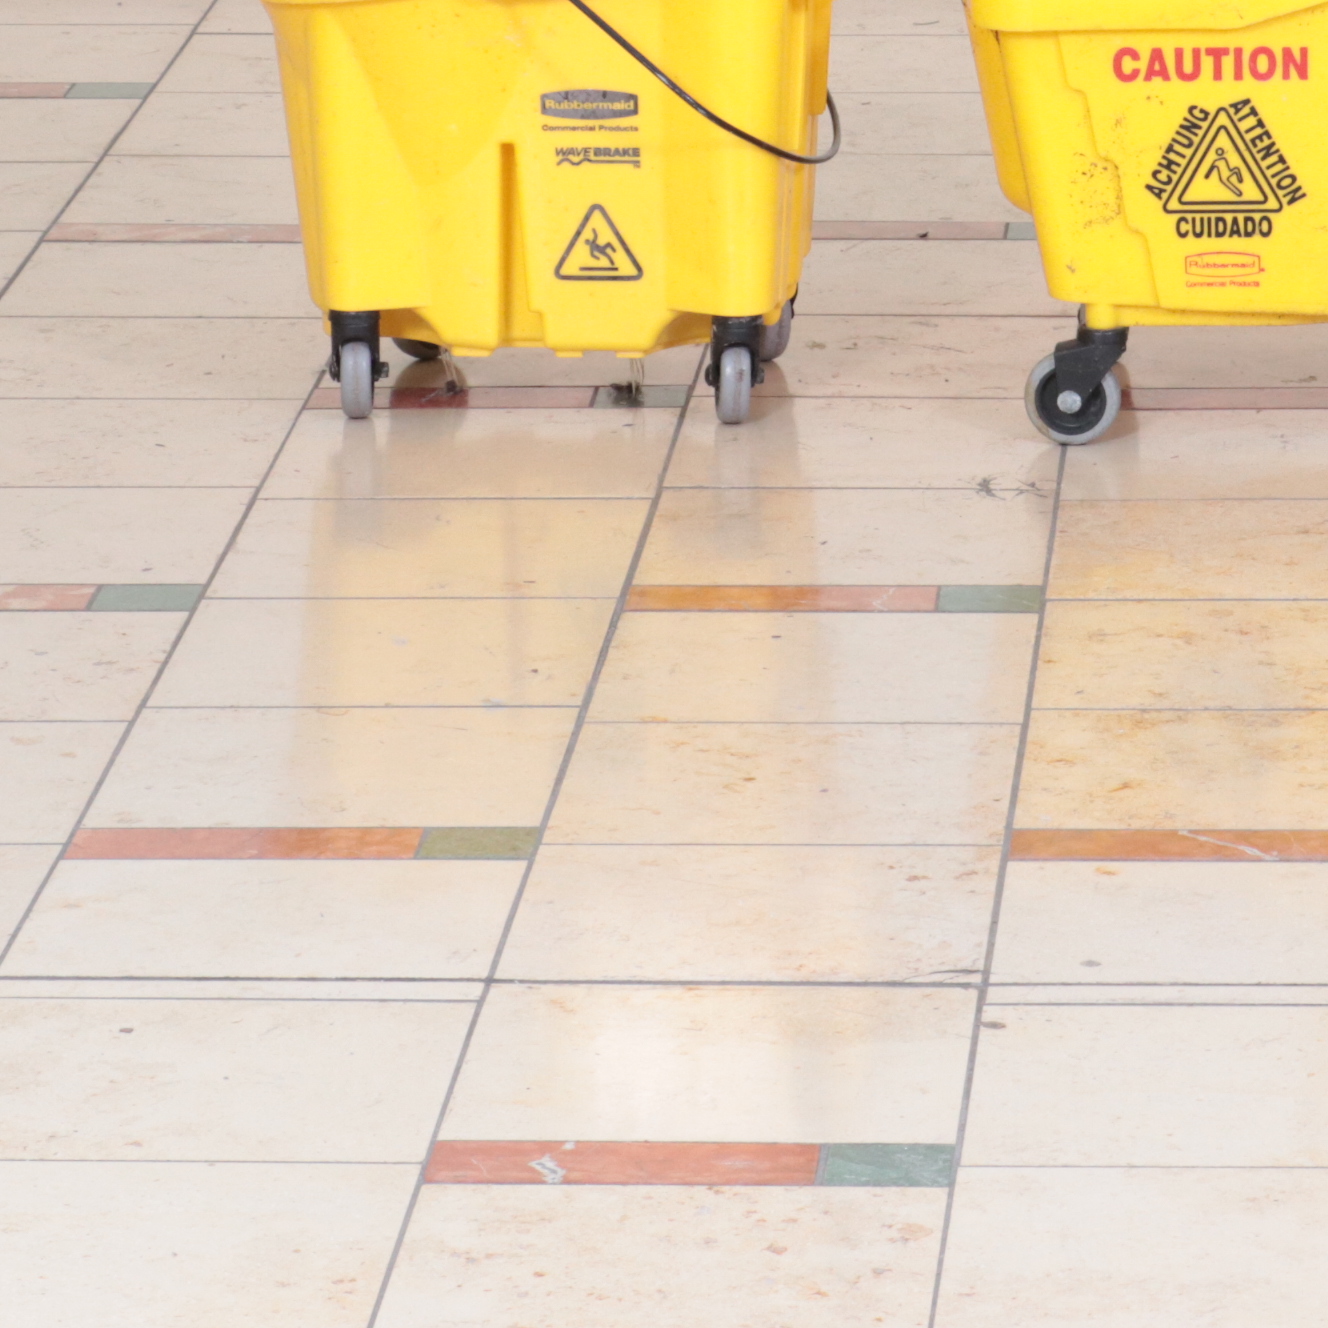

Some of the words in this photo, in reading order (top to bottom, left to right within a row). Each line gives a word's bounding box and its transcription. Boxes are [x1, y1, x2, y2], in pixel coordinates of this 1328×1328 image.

[1112, 46, 1309, 83] CAUTION
[544, 99, 635, 110] Rubbermaid
[542, 124, 596, 132] Commercial
[598, 124, 639, 132] Products
[1144, 104, 1211, 201] ACHTUNG
[1228, 98, 1307, 206] ATTENTION
[1175, 215, 1273, 239] CUIDADO
[1189, 260, 1255, 269] Rubbermaid
